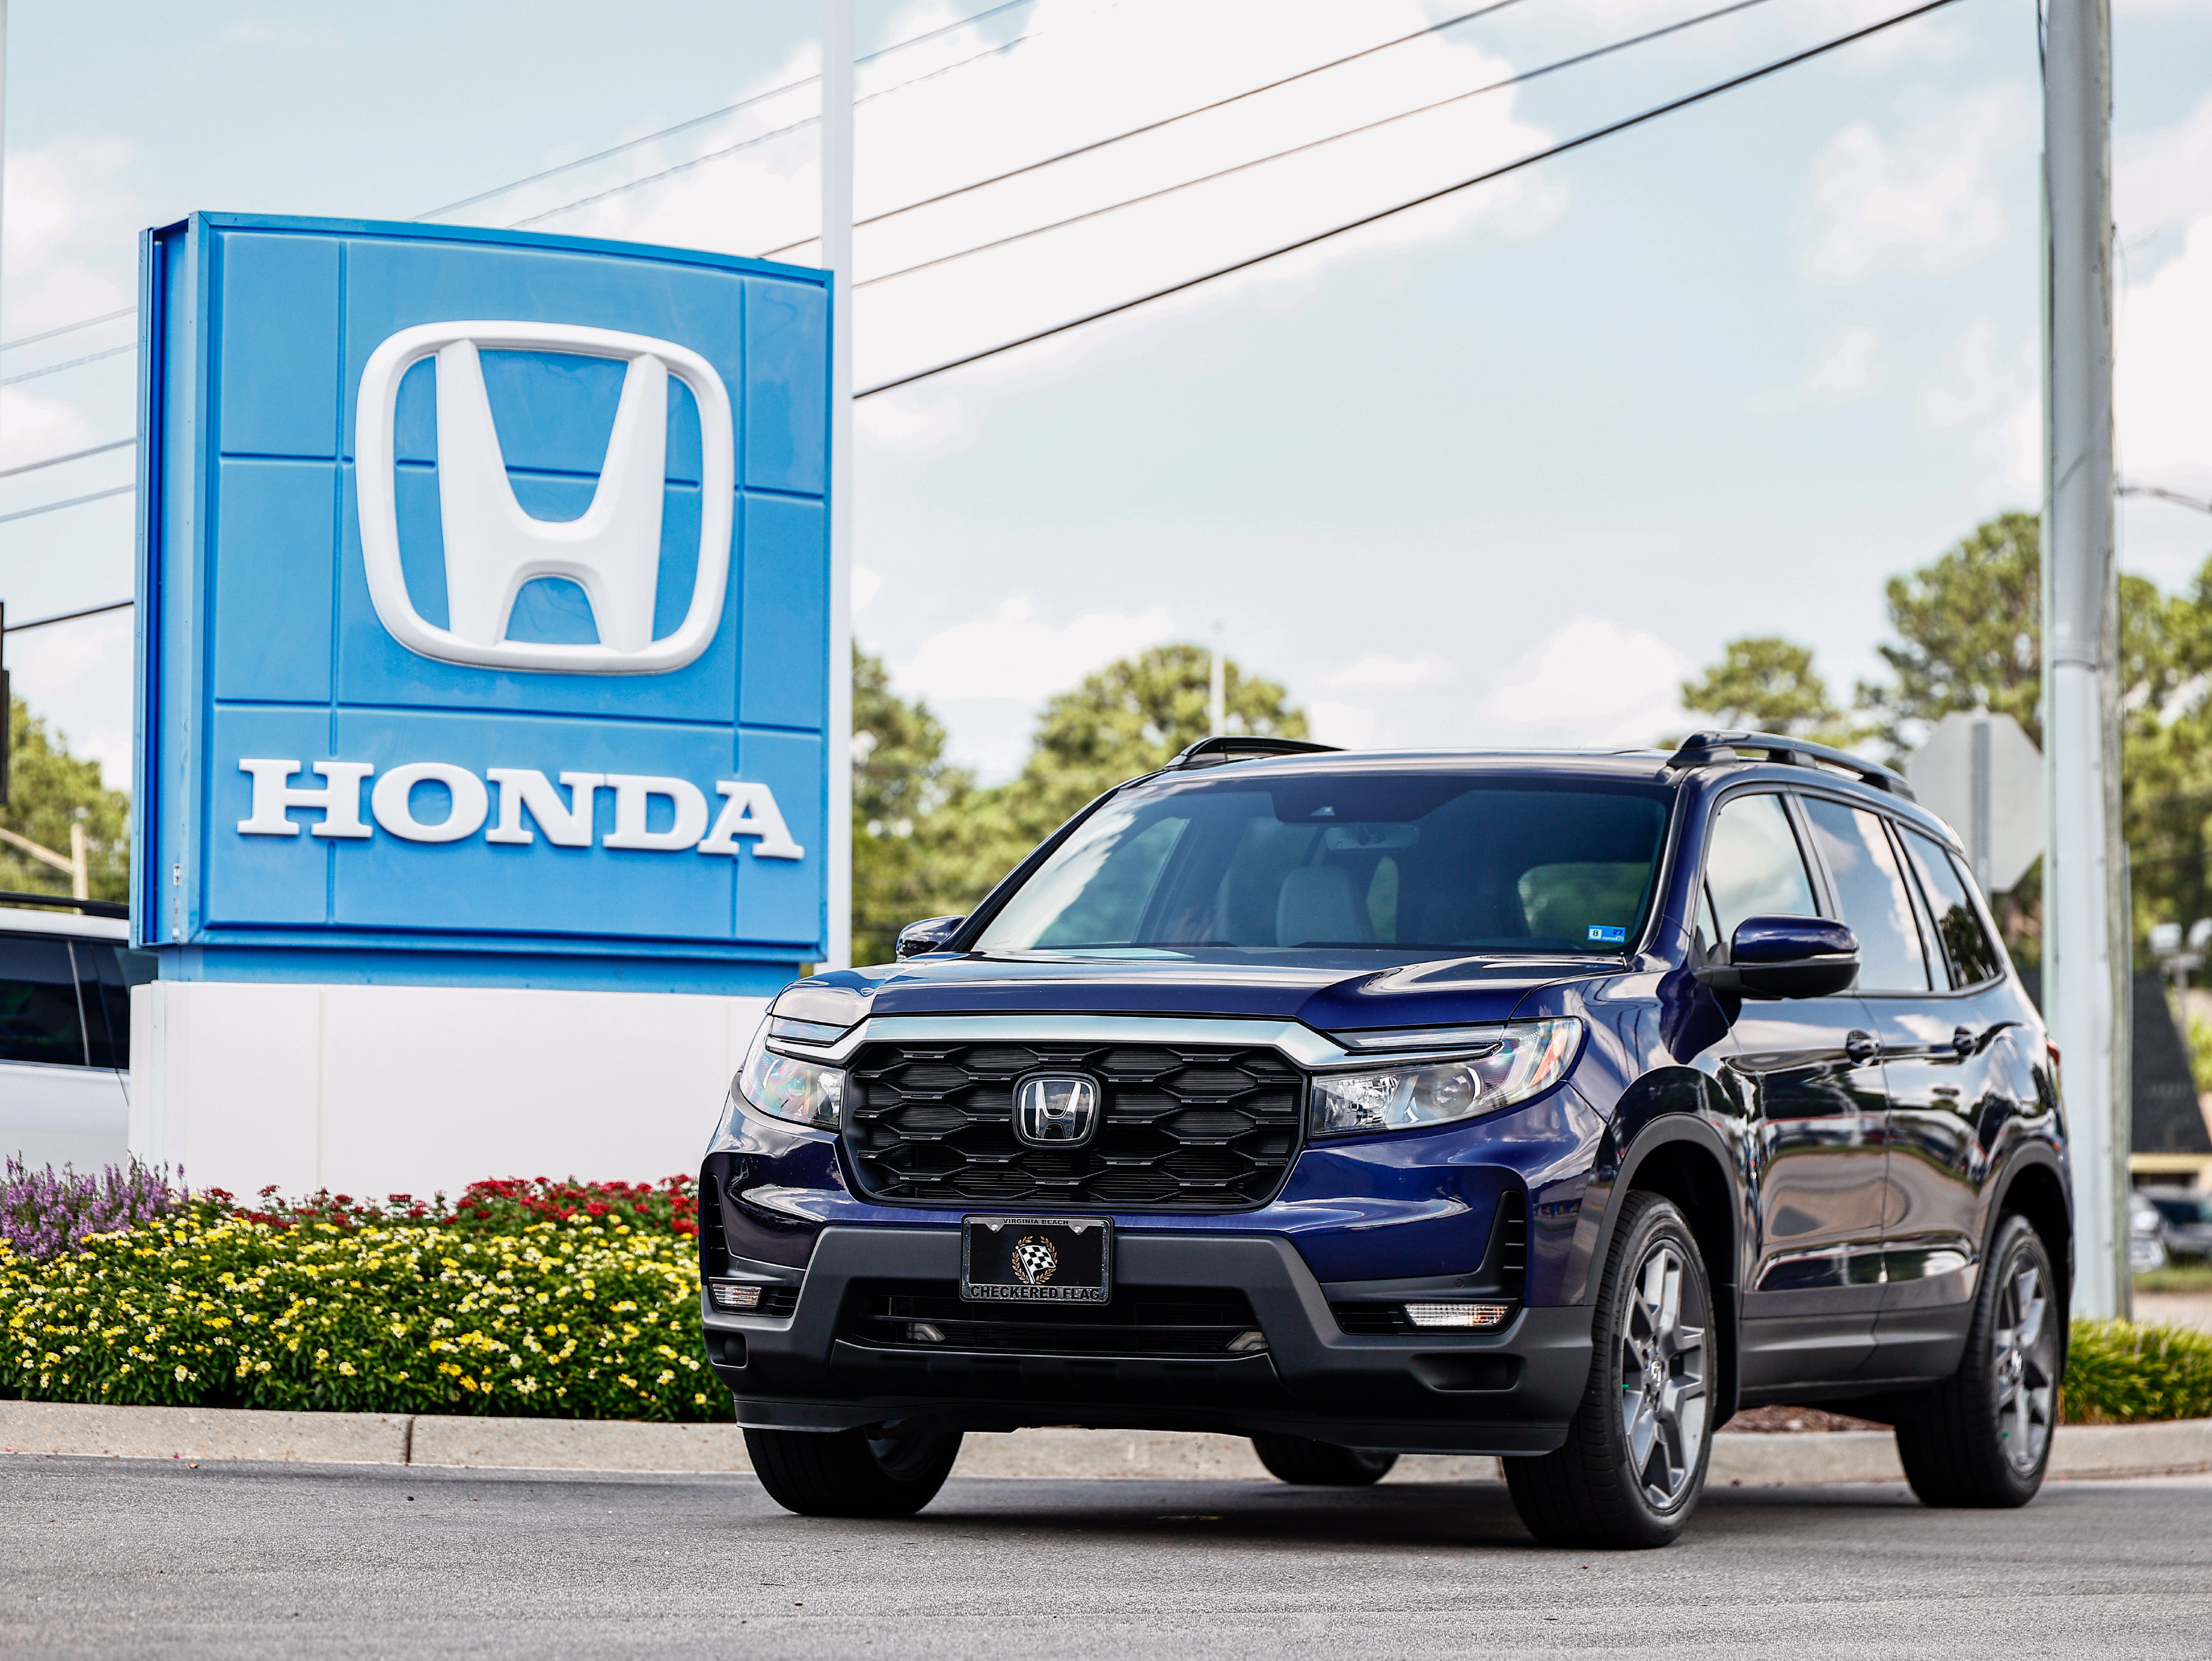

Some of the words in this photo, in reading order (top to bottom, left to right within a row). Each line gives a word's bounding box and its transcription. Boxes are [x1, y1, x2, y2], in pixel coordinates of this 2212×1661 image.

[238, 758, 804, 859] HONDA
[970, 1286, 1058, 1299] CHECKERED
[1063, 1288, 1100, 1300] FLAG
